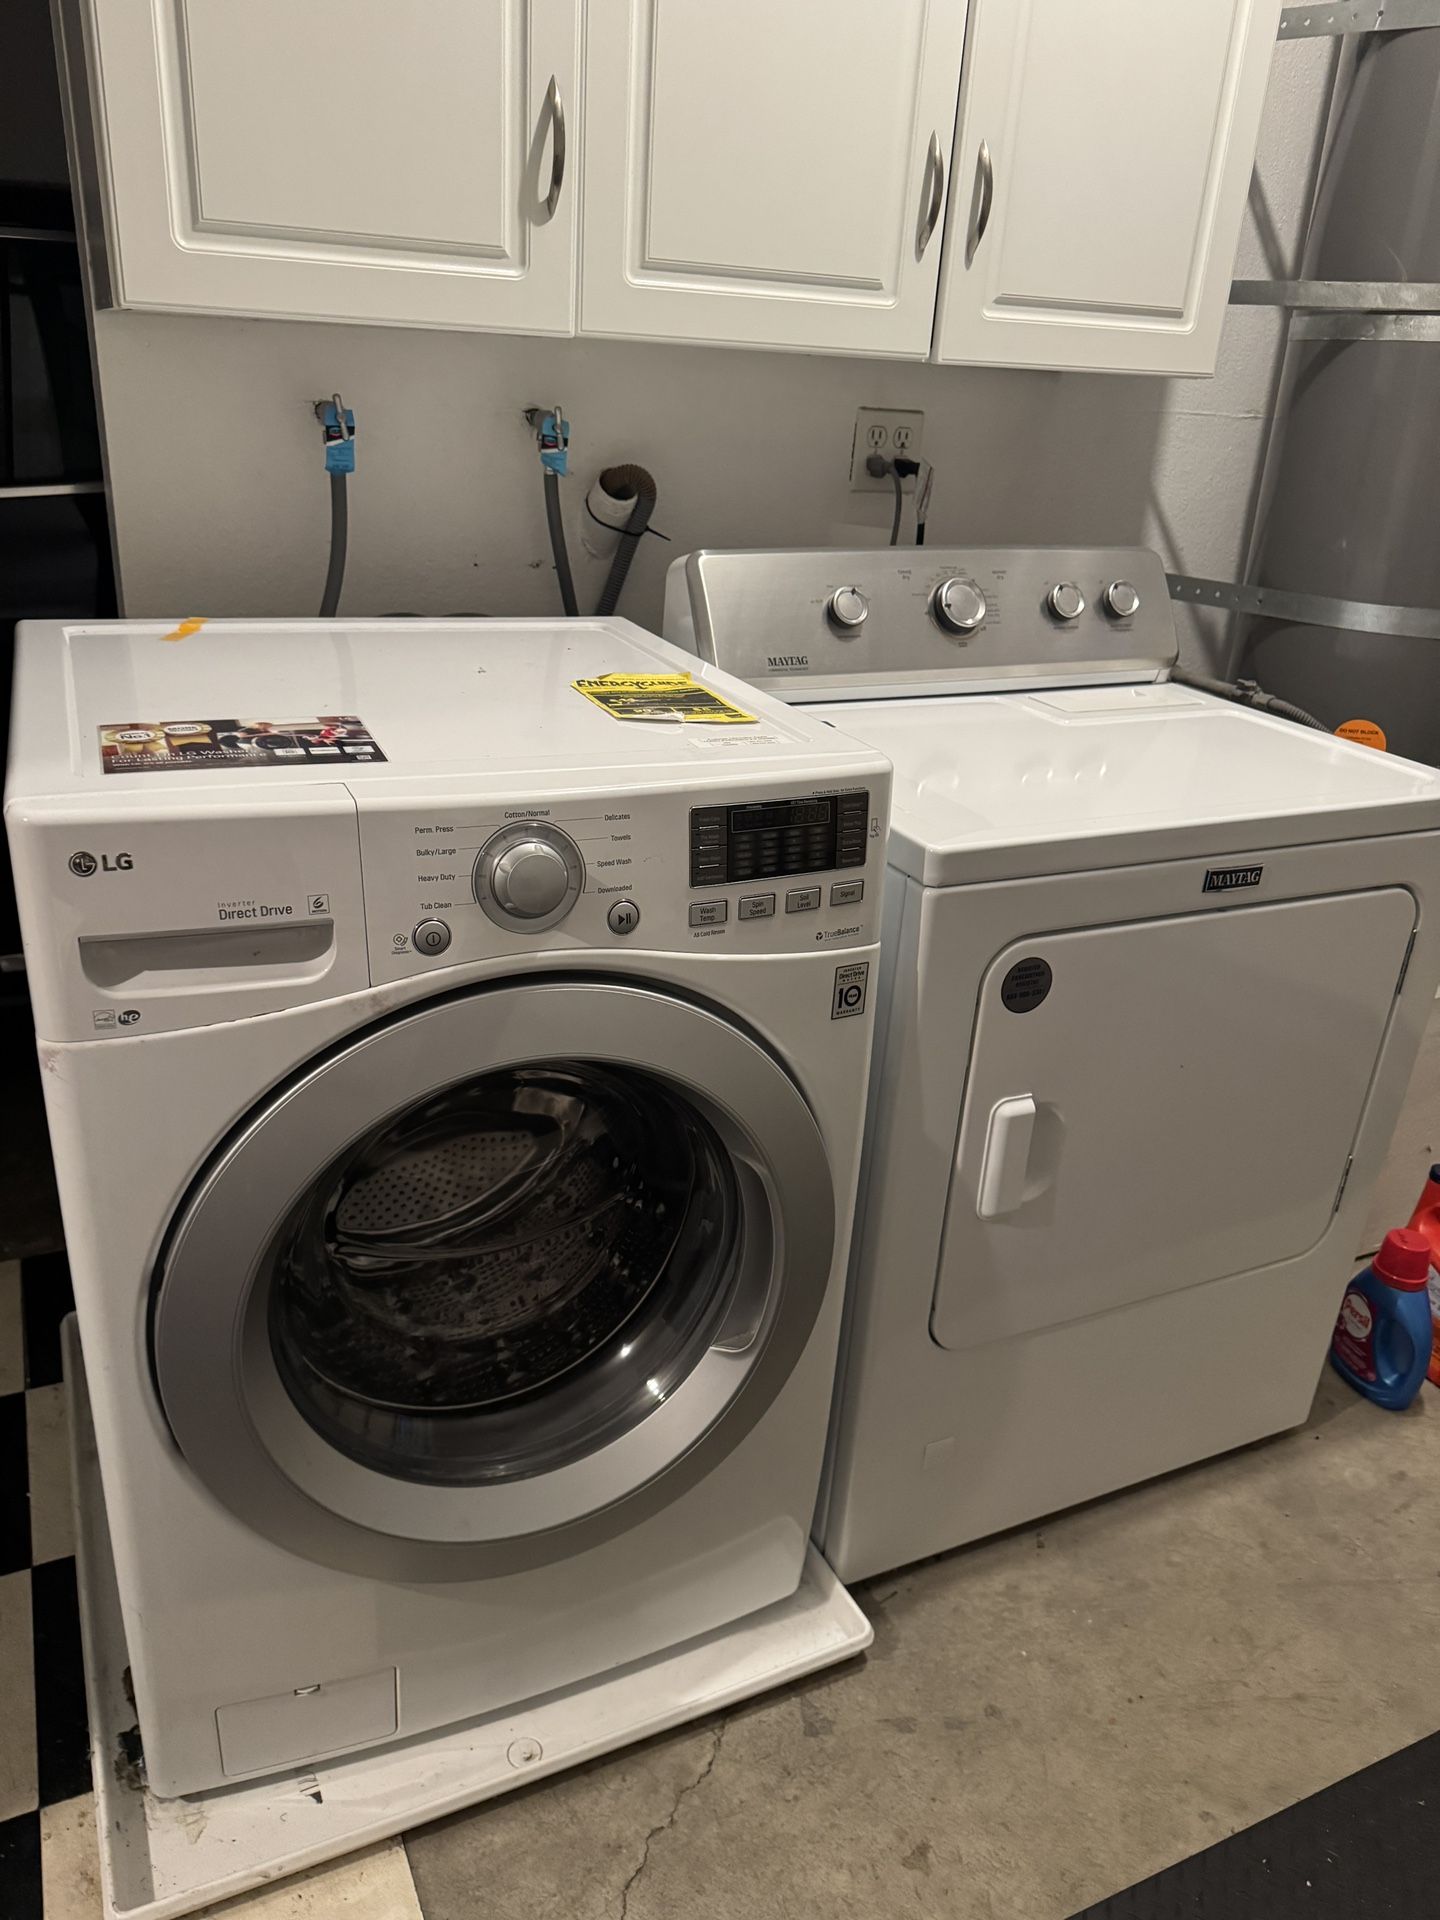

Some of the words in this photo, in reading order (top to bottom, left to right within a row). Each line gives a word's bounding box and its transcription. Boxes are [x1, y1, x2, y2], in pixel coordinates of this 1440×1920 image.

[767, 655, 809, 667] MAYTAG
[504, 810, 550, 819] Cotton/Normal
[604, 813, 631, 821] Delicates
[611, 834, 632, 842] Towels
[416, 848, 457, 857] Bulky/Large
[101, 852, 134, 872] LG
[597, 860, 615, 868] Speed
[418, 875, 439, 883] Heavy
[440, 873, 456, 881] Duty
[1210, 870, 1260, 887] MAYTAG
[597, 884, 633, 895] Downloaded
[839, 889, 856, 898] Signal
[217, 900, 255, 908] Inverter
[420, 902, 432, 910] Tub
[434, 901, 452, 909] Clean
[752, 900, 764, 909] Spin
[797, 900, 812, 909] Level
[219, 907, 258, 921] Direct
[260, 905, 293, 917] Drive
[700, 906, 717, 915] Wash
[749, 907, 767, 916] Speed
[824, 926, 860, 938] TrueBalance
[838, 985, 862, 1009] 10
